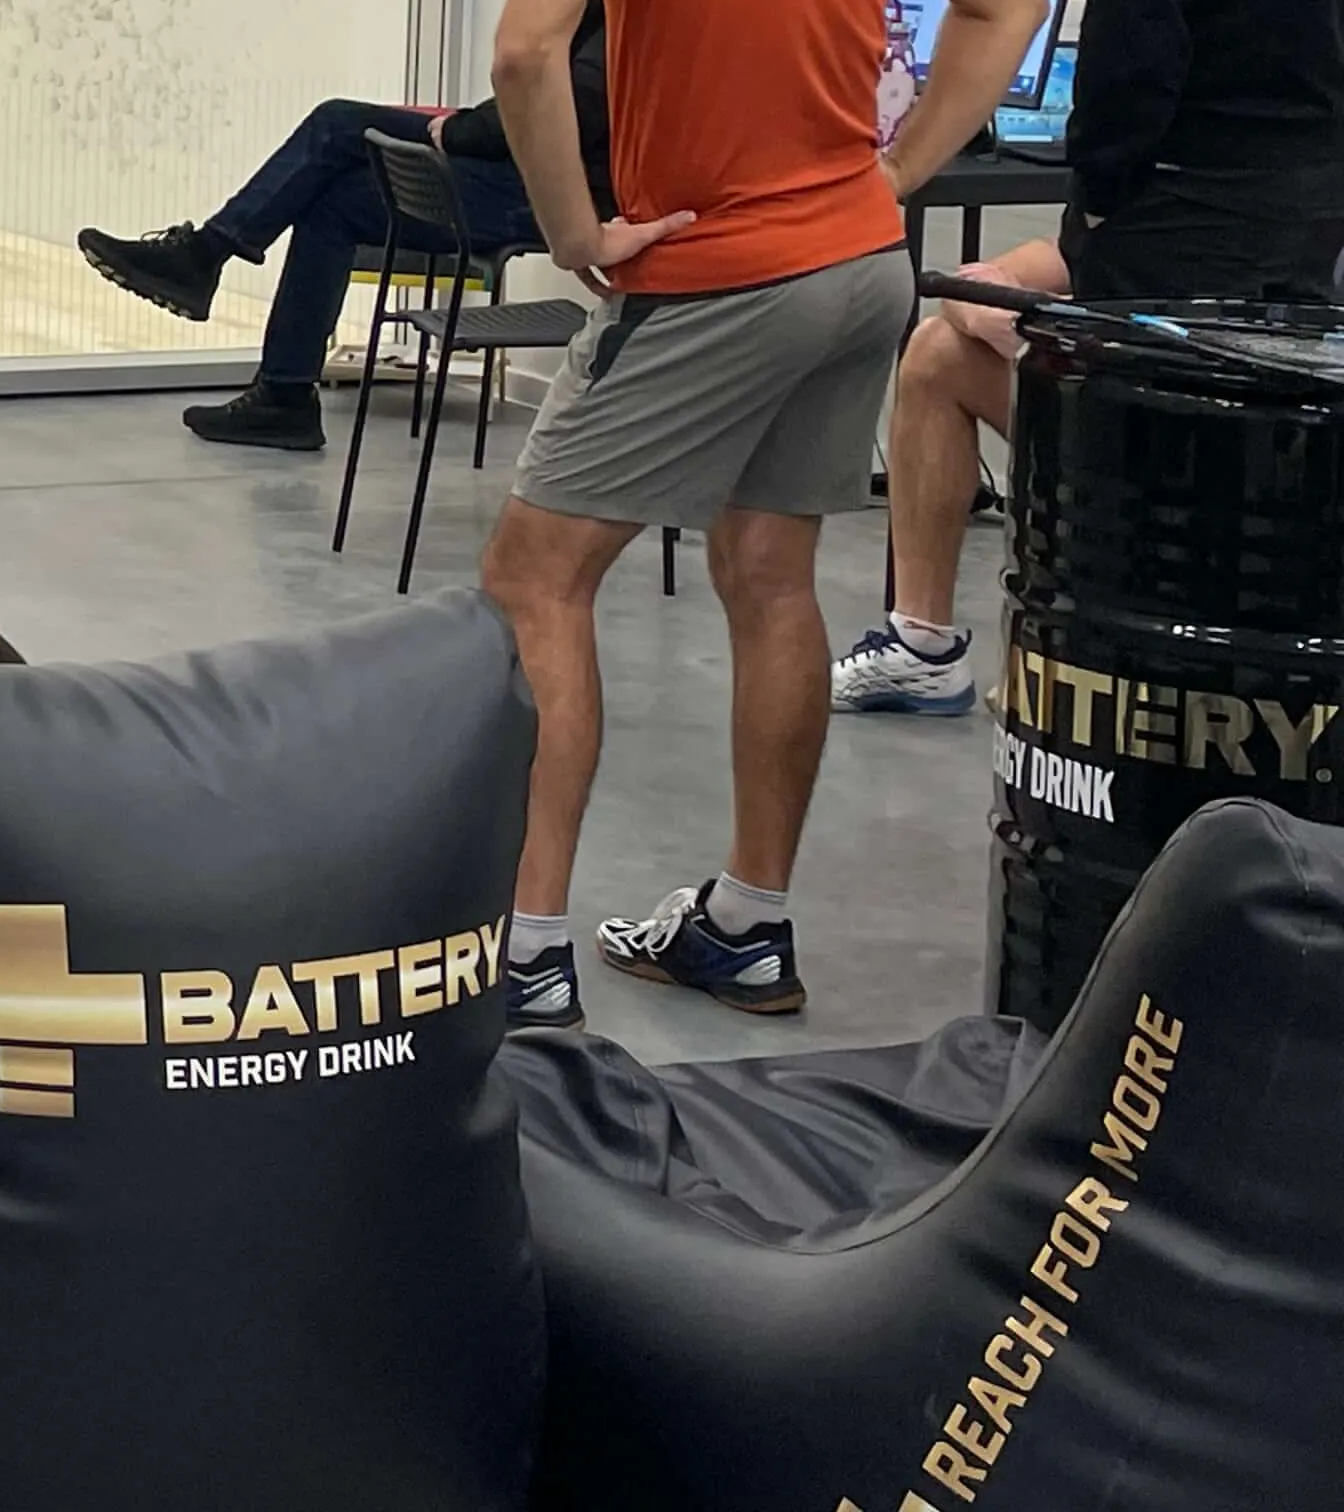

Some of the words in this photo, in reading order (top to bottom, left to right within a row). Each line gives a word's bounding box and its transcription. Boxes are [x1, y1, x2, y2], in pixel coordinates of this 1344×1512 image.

[1004, 644, 1340, 781] ATTERY
[1030, 746, 1115, 823] DRINK
[160, 914, 507, 1045] BATTERY
[165, 1049, 309, 1090] ENERGY
[318, 1031, 416, 1079] DRINK
[921, 1295, 1070, 1504] REACH
[1029, 1176, 1130, 1304] FOR
[1089, 992, 1185, 1182] MORE
